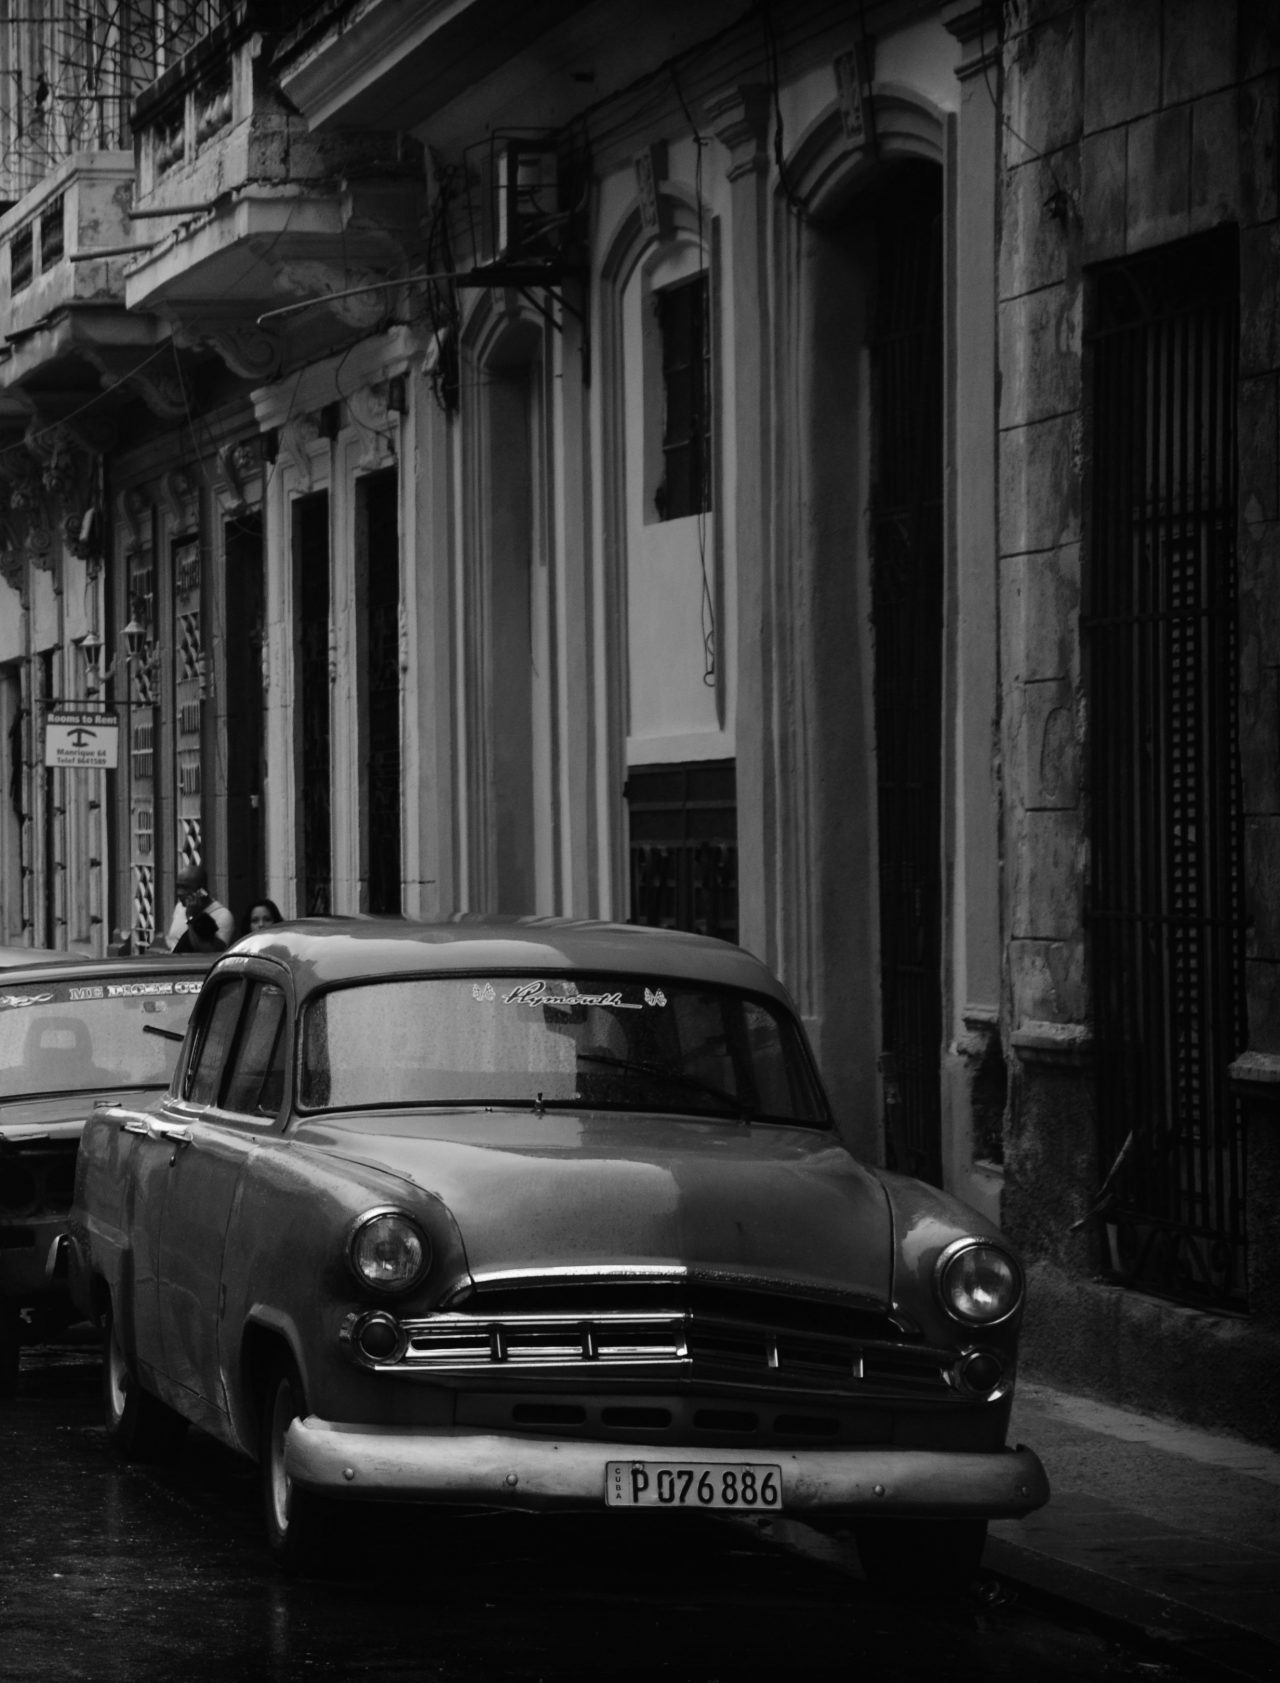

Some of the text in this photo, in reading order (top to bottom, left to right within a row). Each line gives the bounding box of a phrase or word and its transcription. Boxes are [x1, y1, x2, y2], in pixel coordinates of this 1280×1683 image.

[47, 713, 118, 725] Rooms to Rent
[56, 748, 95, 758] Manrique
[501, 979, 644, 1010] Plymouth
[614, 1467, 622, 1500] CUBA
